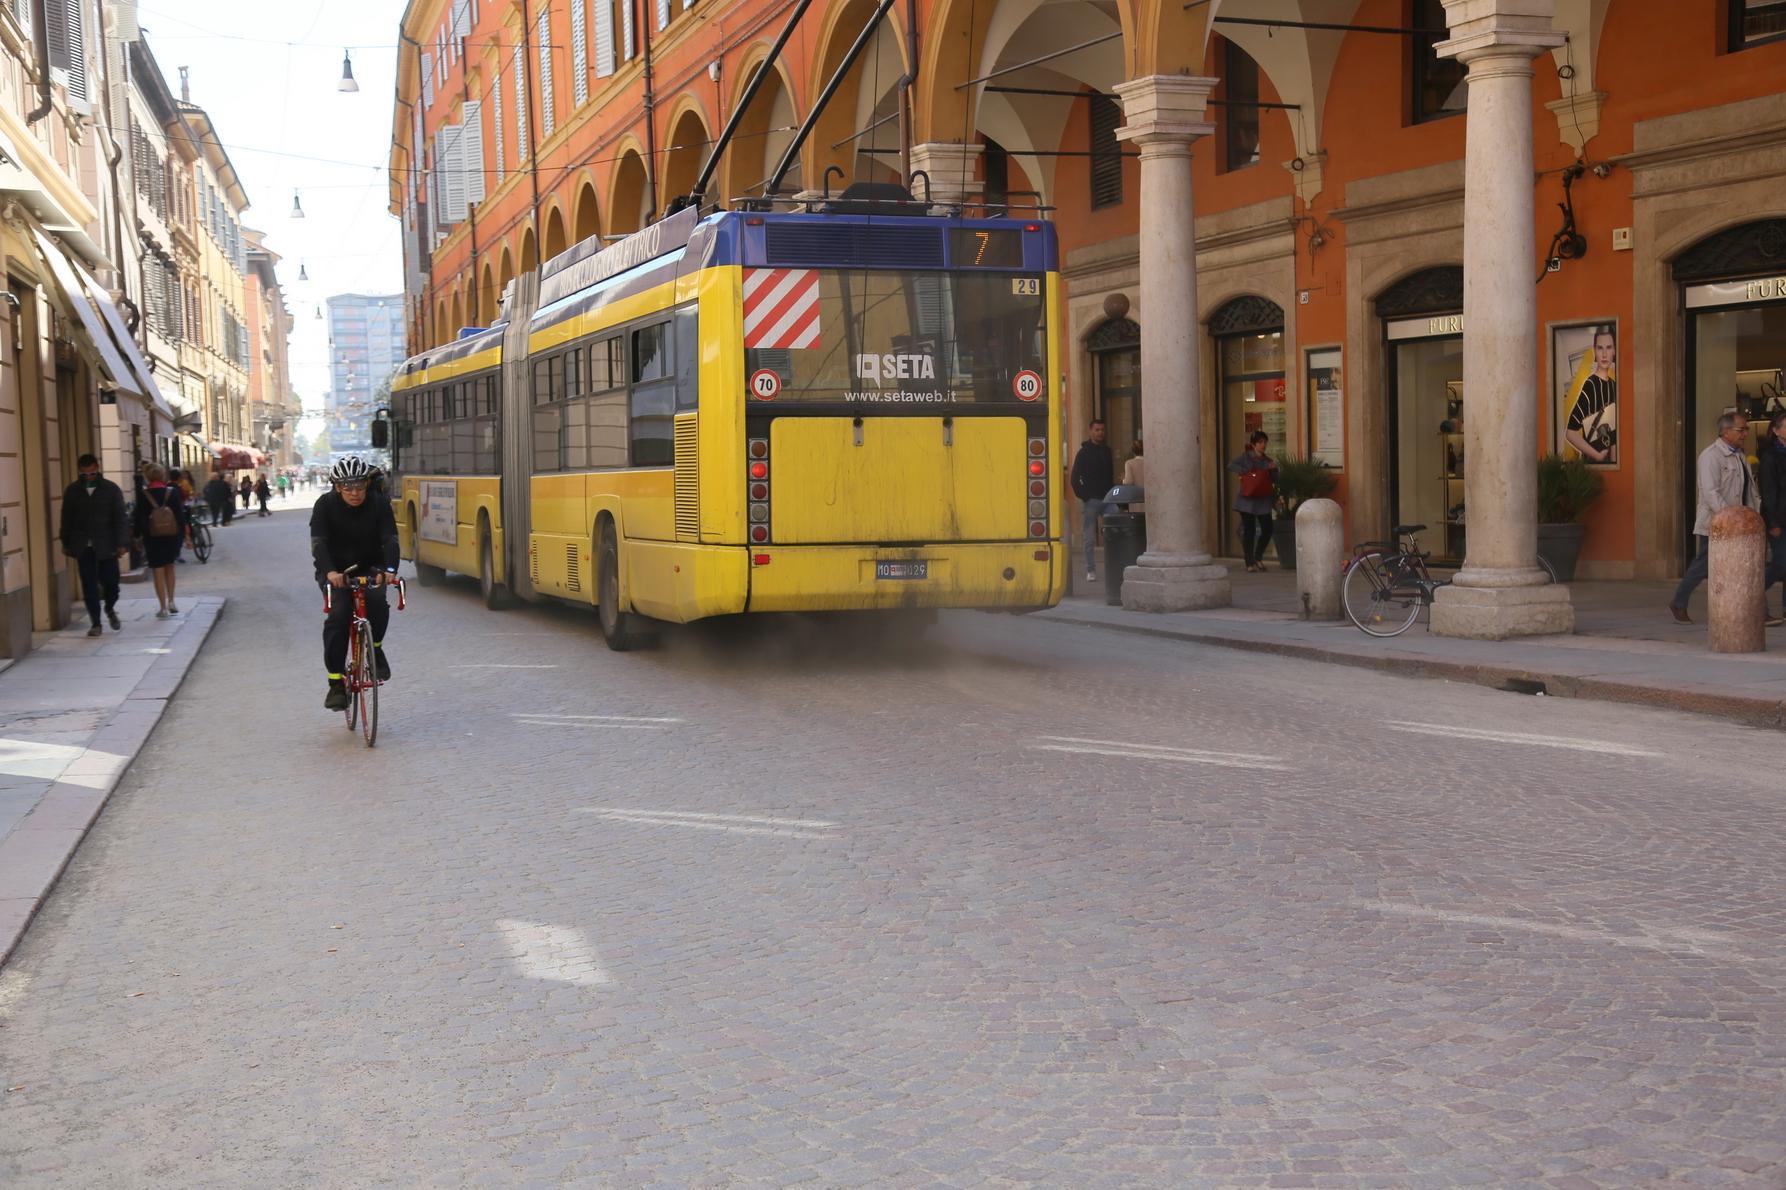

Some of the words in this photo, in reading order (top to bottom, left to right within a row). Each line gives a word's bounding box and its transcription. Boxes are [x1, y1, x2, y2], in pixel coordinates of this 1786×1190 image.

[975, 232, 989, 265] 7
[1018, 280, 1037, 294] 29
[882, 354, 935, 379] SETA
[759, 378, 773, 391] 70
[1020, 379, 1034, 392] 80
[844, 390, 957, 403] www.setaweb.it
